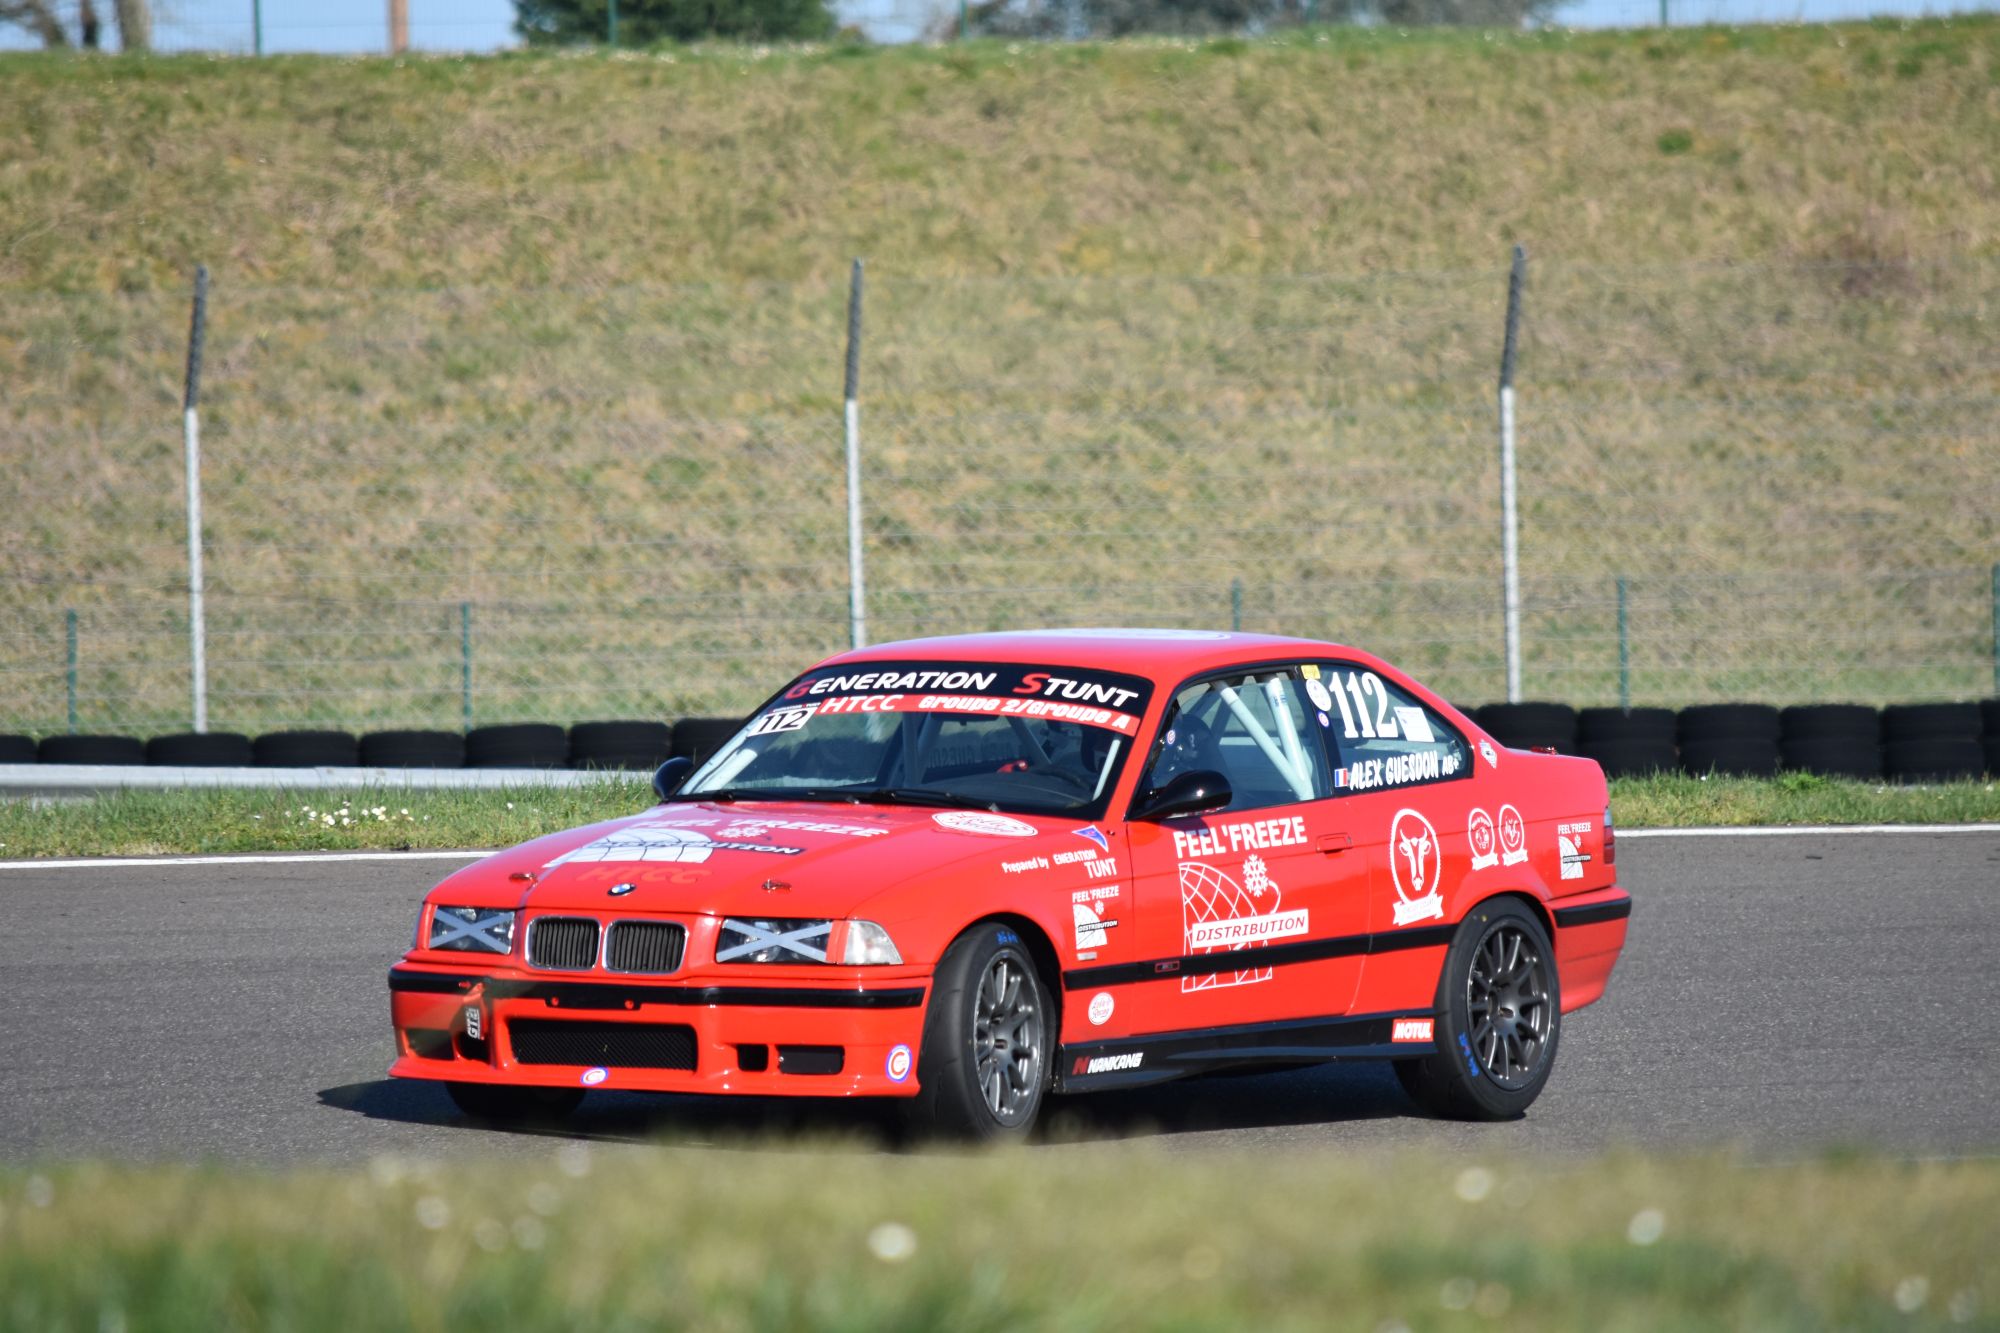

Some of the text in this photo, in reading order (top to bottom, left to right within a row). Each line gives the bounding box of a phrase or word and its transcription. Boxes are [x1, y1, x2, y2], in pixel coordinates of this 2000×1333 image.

[785, 671, 1139, 707] GENERATION STUNT
[819, 694, 904, 714] HTCC
[1112, 714, 1131, 729] A
[1329, 671, 1399, 738] 112
[757, 710, 809, 734] 112
[1349, 758, 1384, 791] ALEX
[1385, 750, 1440, 786] GUESDON
[1442, 754, 1460, 776] AB+
[1173, 816, 1308, 859] FEEL'FREEZE
[575, 866, 713, 884] HTCC
[1001, 857, 1038, 874] Prepared
[1037, 857, 1050, 870] by
[1072, 886, 1119, 903] FEEL'FREEZE
[1196, 917, 1305, 942] DISTRIBUTION
[1393, 1022, 1432, 1039] MOTUL
[1087, 1052, 1145, 1074] NANKANG
